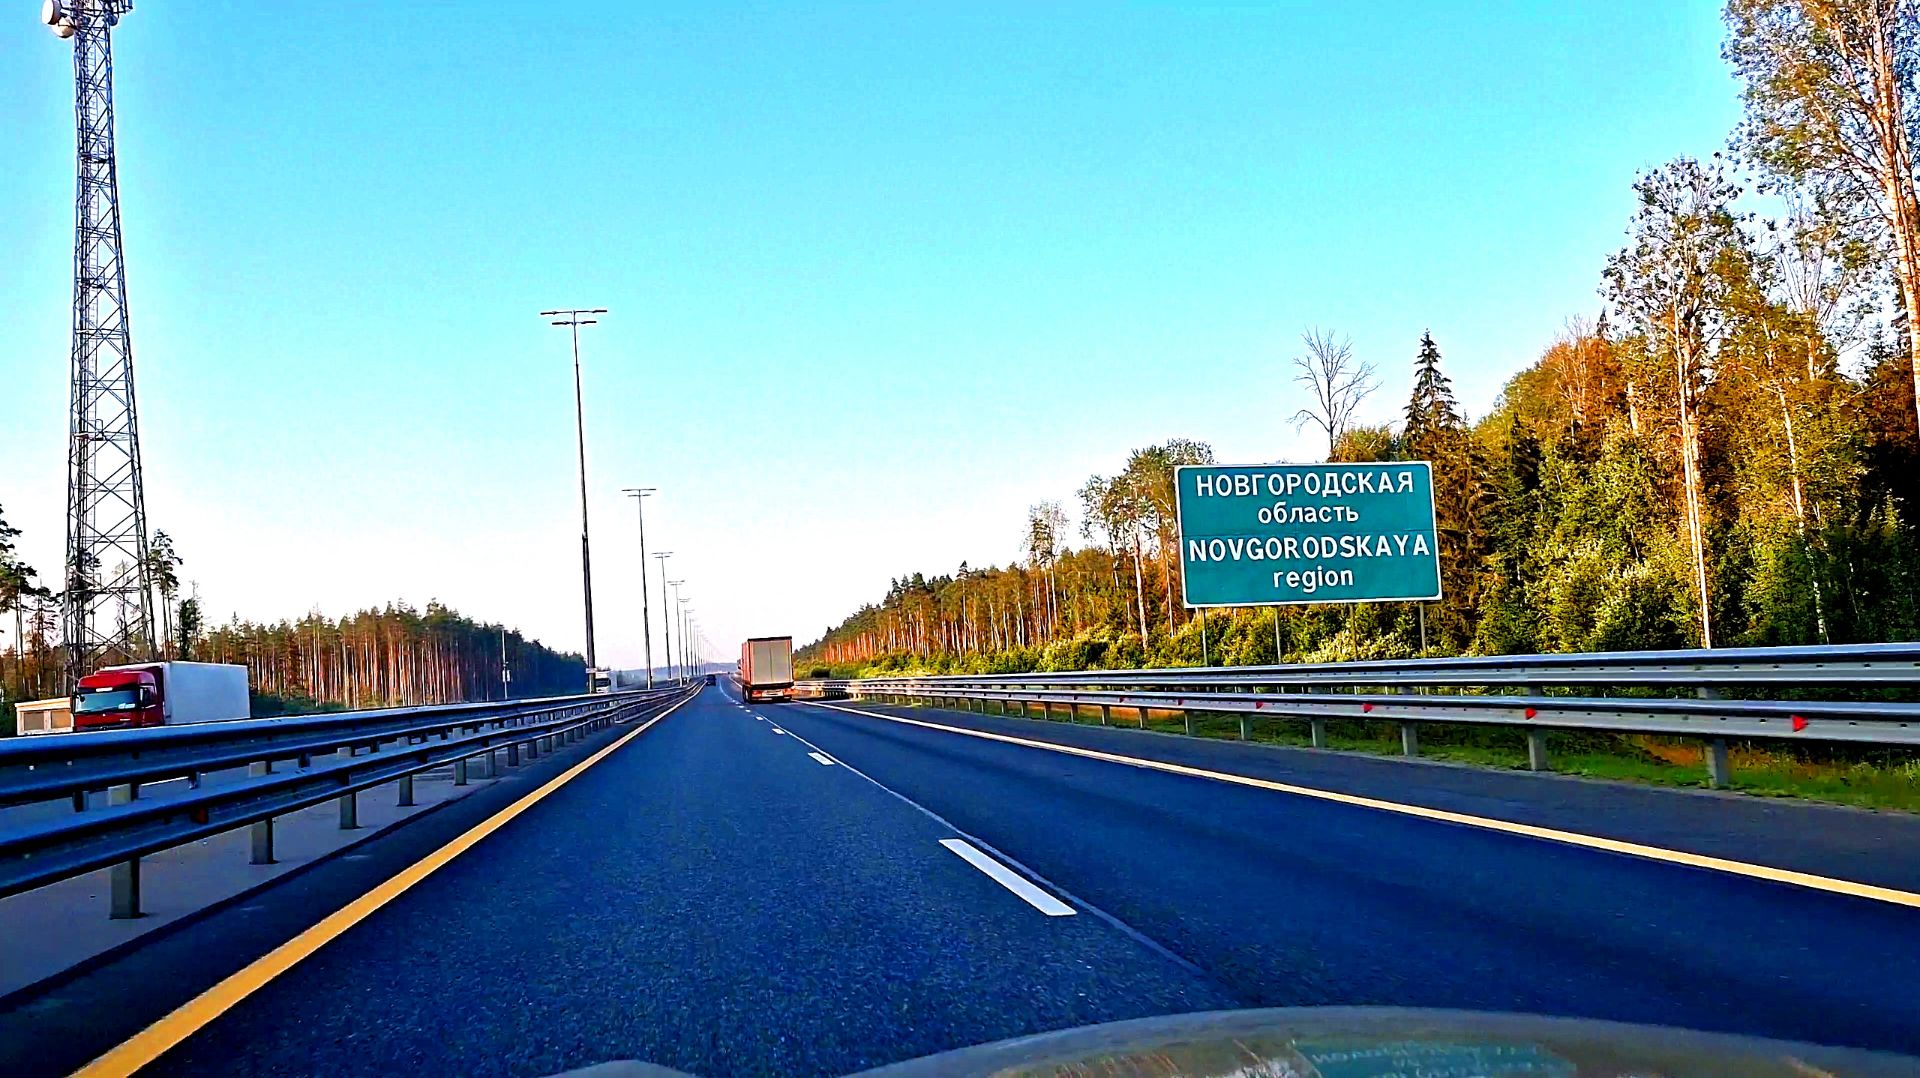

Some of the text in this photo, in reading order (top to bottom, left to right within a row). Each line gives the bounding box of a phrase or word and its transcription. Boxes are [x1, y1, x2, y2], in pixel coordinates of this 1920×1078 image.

[1196, 471, 1414, 498] НОВГОРОДСКАЯ
[1257, 501, 1359, 524] область
[1188, 534, 1430, 562] NOVGORODSKAYA
[1273, 565, 1354, 593] region
